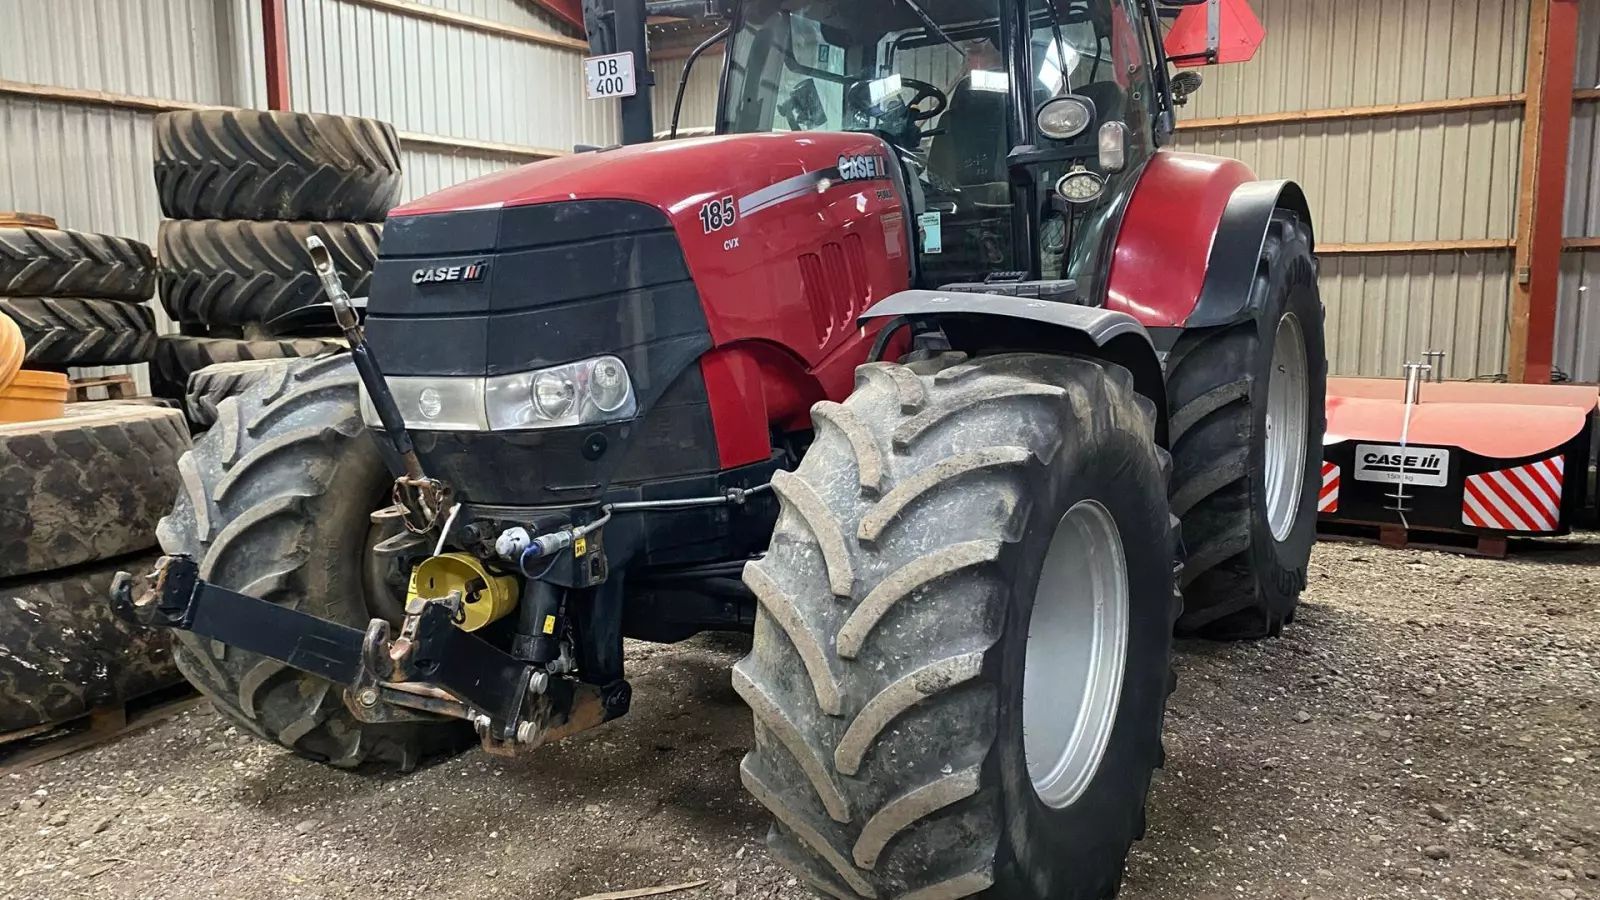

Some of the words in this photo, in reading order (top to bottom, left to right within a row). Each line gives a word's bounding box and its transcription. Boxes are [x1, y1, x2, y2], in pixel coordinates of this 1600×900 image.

[597, 59, 618, 77] DB
[596, 76, 623, 95] 400
[838, 155, 875, 180] CASE
[699, 195, 736, 235] 185
[723, 238, 739, 251] CVX
[411, 266, 460, 283] CASE
[1363, 453, 1418, 467] CASE
